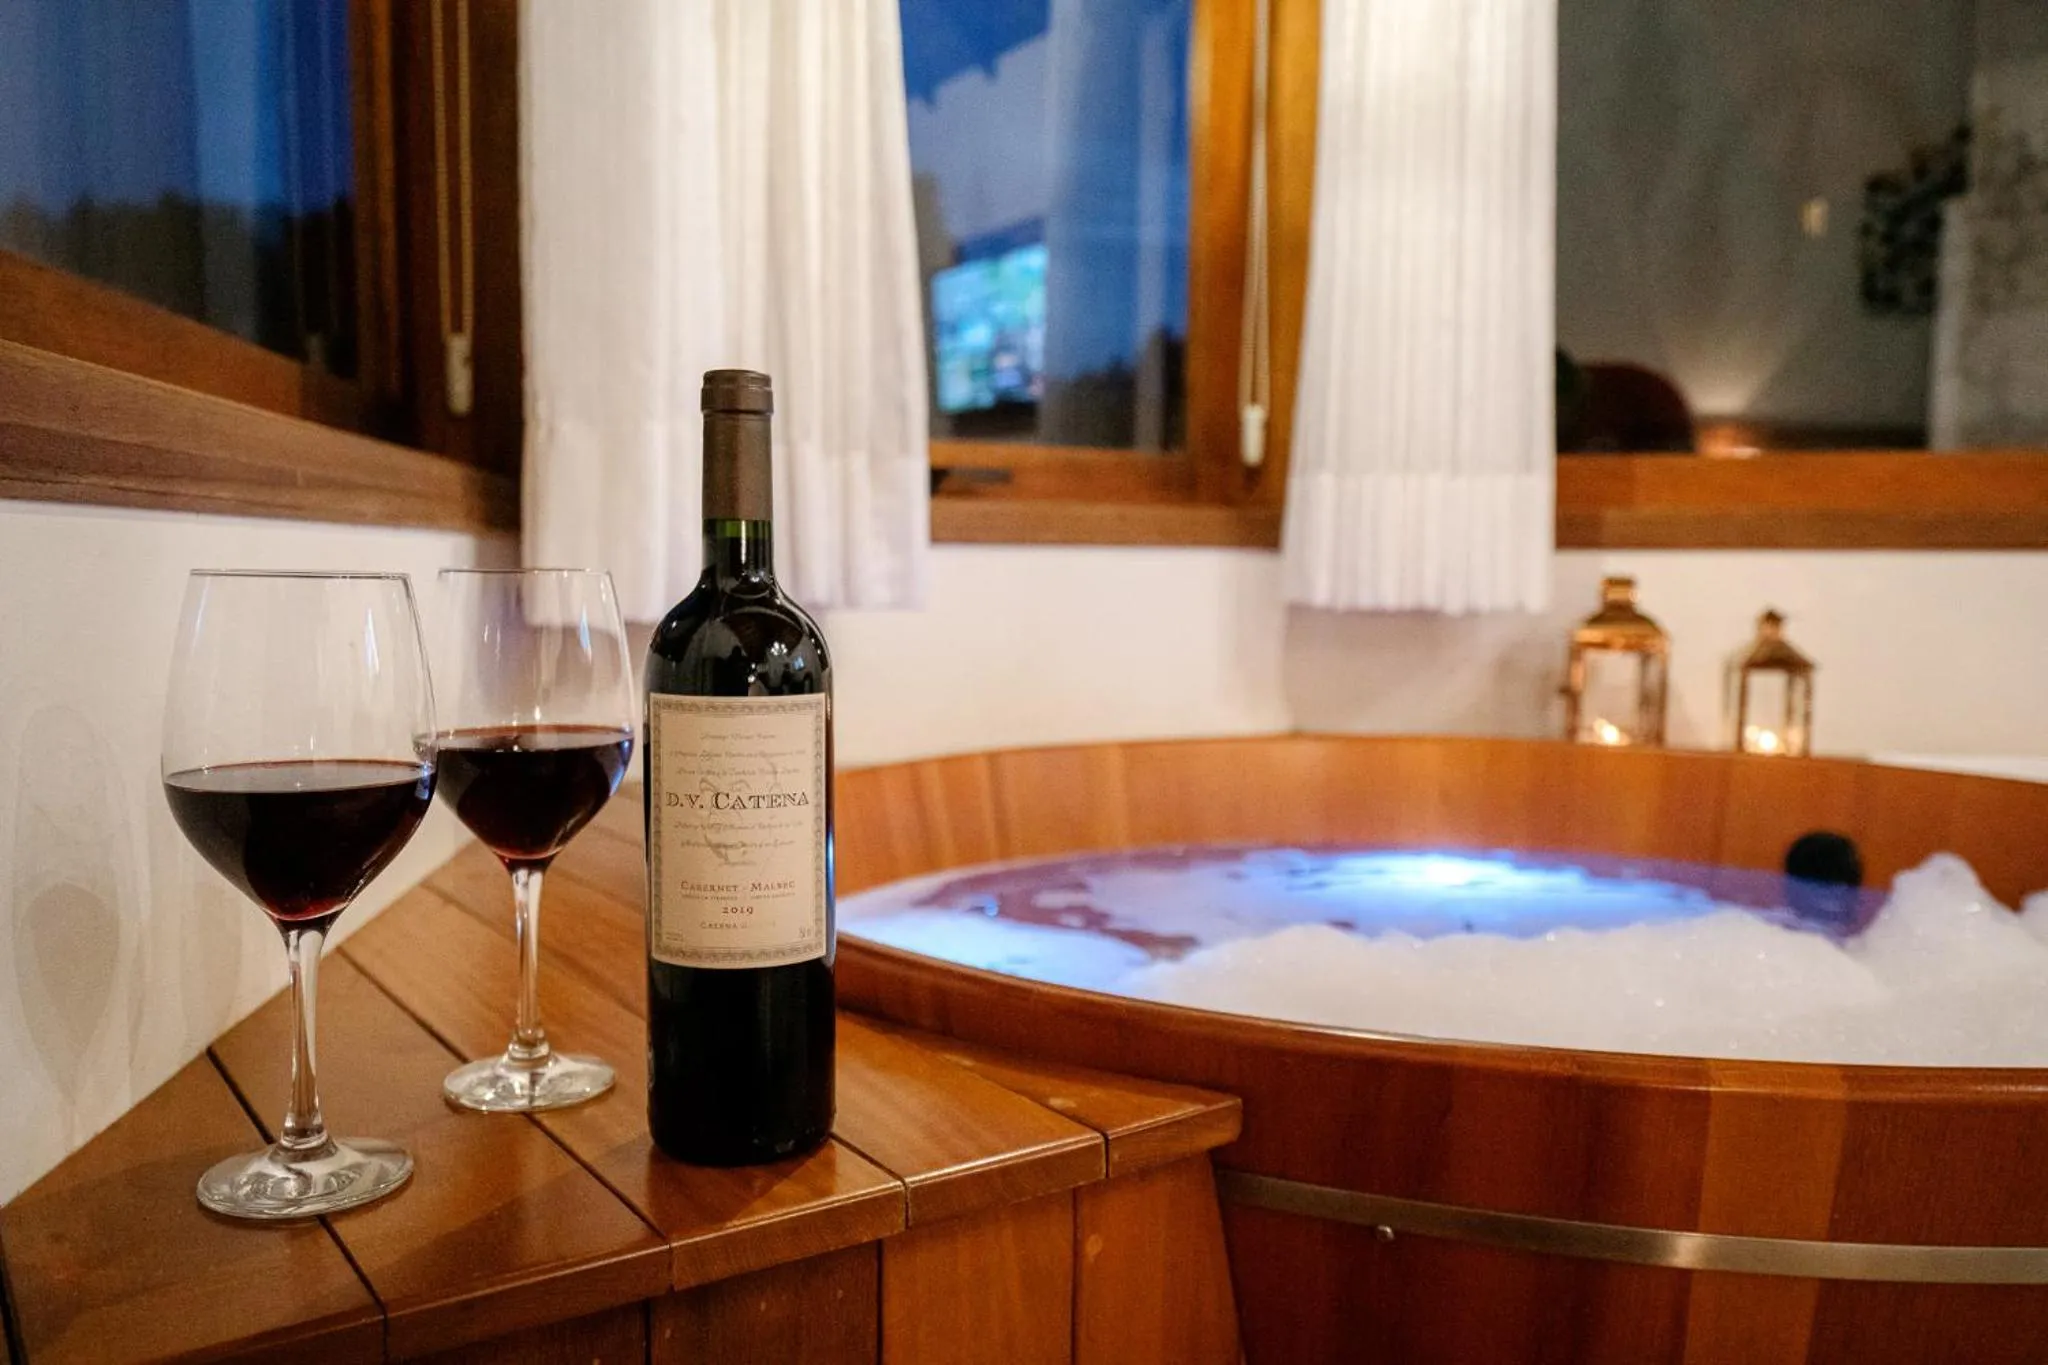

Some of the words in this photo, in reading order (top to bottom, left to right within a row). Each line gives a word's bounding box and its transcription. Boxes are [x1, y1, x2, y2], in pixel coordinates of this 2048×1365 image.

[666, 791, 704, 809] D.V.
[714, 791, 810, 810] CATENA
[680, 880, 738, 893] CABERNET
[750, 880, 796, 893] MALBEC
[722, 906, 754, 915] 2019
